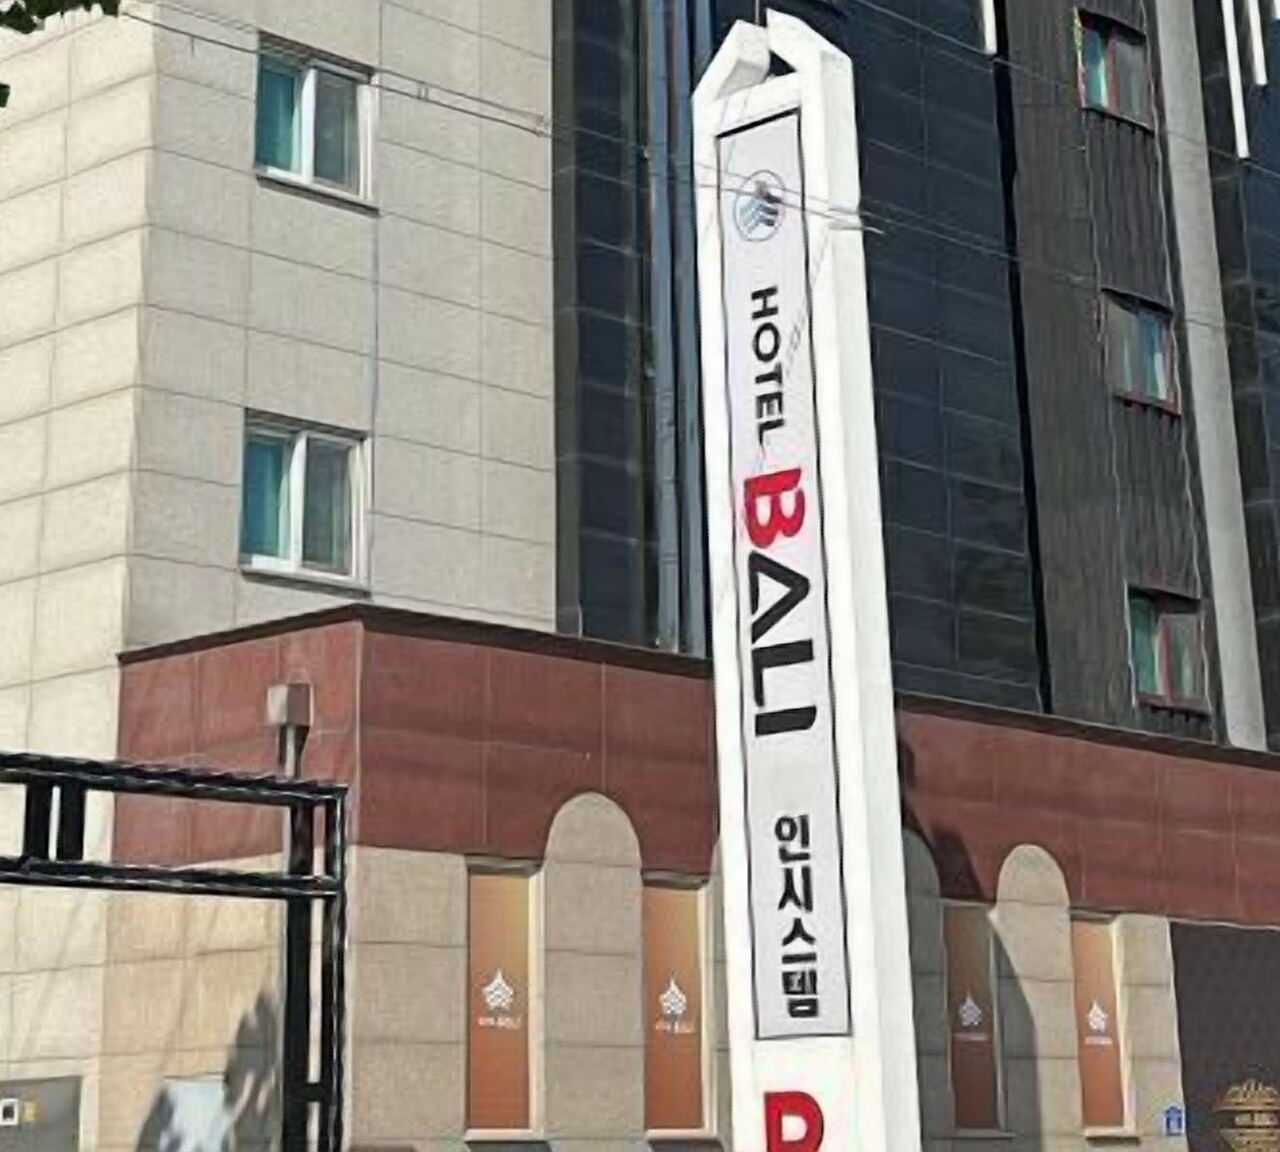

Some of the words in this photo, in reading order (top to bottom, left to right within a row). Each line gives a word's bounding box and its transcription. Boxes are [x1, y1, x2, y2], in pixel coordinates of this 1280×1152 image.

[751, 283, 785, 451] HOTEL
[744, 467, 817, 737] BALI
[774, 813, 819, 1018] 인시스템
